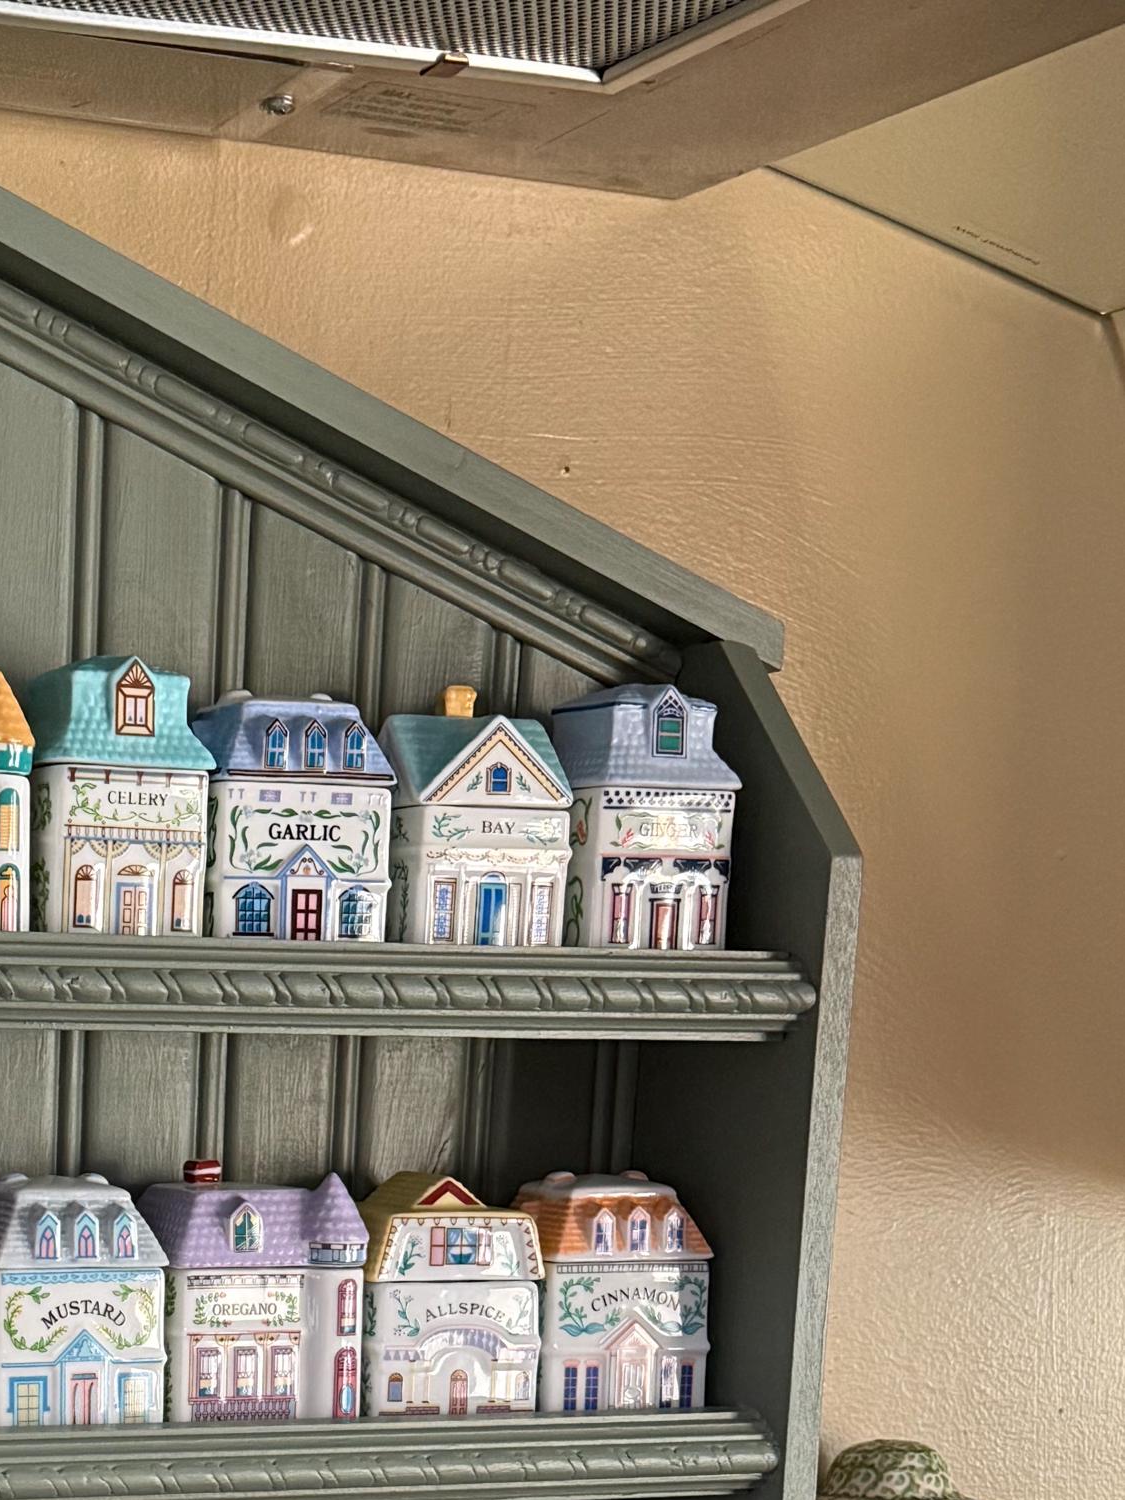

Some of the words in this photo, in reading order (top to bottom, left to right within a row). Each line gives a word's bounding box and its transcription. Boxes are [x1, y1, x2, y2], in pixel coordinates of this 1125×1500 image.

[107, 790, 169, 806] CELERY
[268, 824, 341, 842] GARLIC
[481, 821, 516, 835] BAY
[639, 822, 698, 838] GINGER
[591, 1287, 681, 1313] CINNAMON
[40, 1299, 126, 1330] MUSTARD
[212, 1302, 278, 1317] OREGANO
[425, 1302, 507, 1323] ALLSPICE
